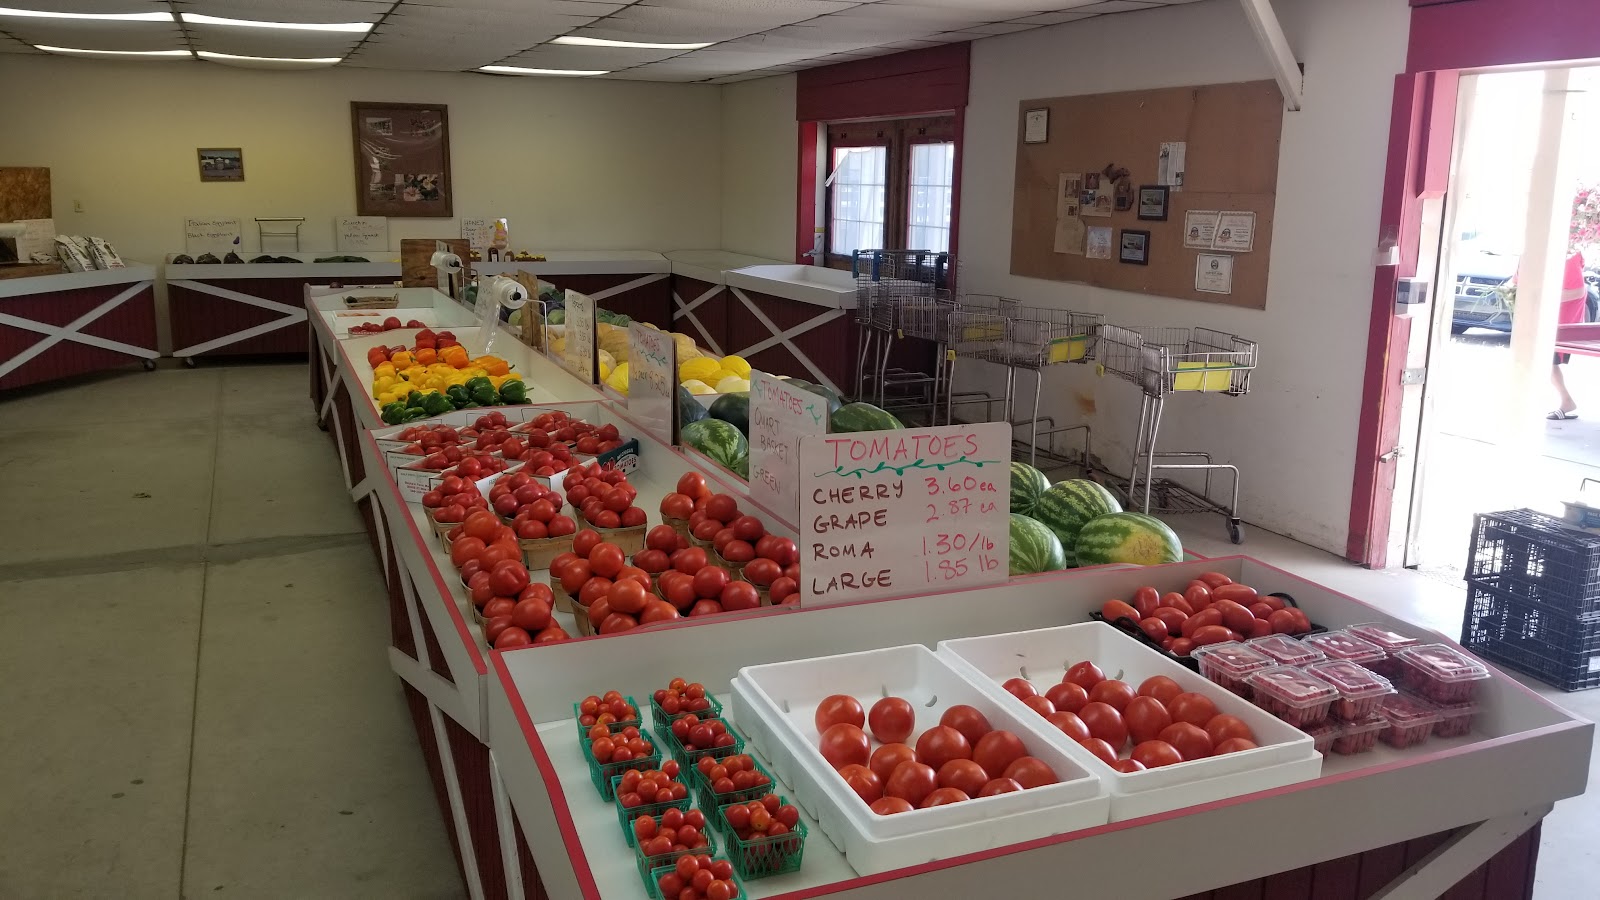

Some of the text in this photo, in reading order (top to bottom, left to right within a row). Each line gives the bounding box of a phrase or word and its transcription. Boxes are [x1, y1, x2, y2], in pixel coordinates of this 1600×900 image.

[761, 379, 803, 415] TOMATOES
[754, 407, 780, 436] QUART
[760, 434, 788, 464] BASKET
[825, 434, 978, 468] TOMATOES
[753, 464, 780, 495] GREEN
[812, 480, 904, 505] CHERRY
[813, 497, 999, 534] GRAPE 2.87 ea
[812, 532, 994, 562] ROMA 1.30/lb
[812, 554, 999, 595] LARGE 1.85 lb
